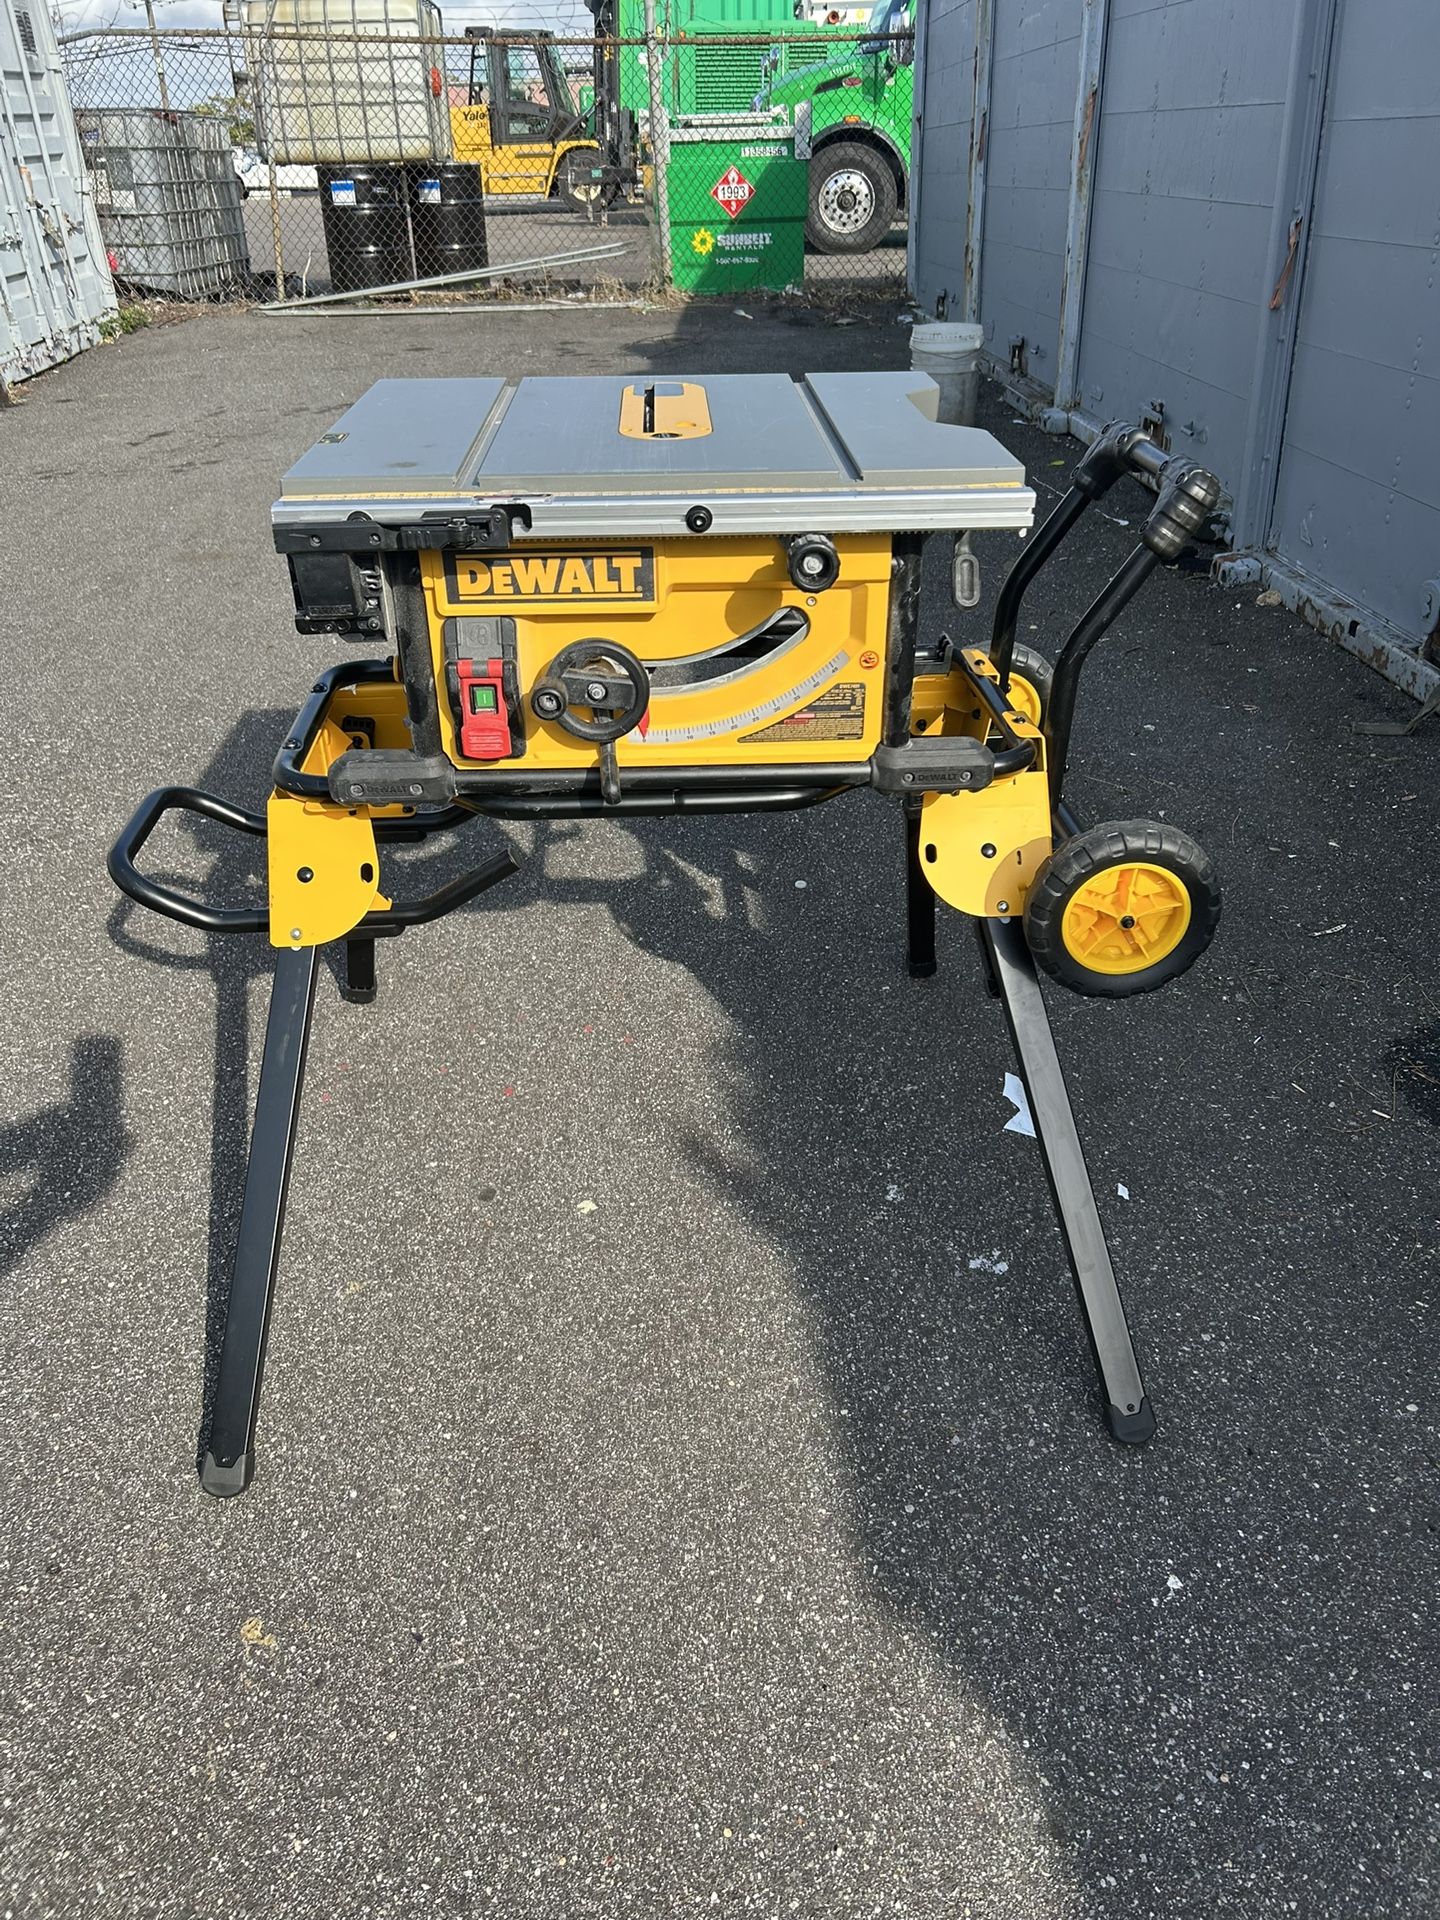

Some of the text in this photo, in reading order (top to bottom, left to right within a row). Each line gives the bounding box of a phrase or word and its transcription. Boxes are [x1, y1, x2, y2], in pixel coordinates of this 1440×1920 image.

[463, 111, 486, 121] Yale
[721, 185, 746, 199] 1993
[455, 556, 643, 595] DEWALT
